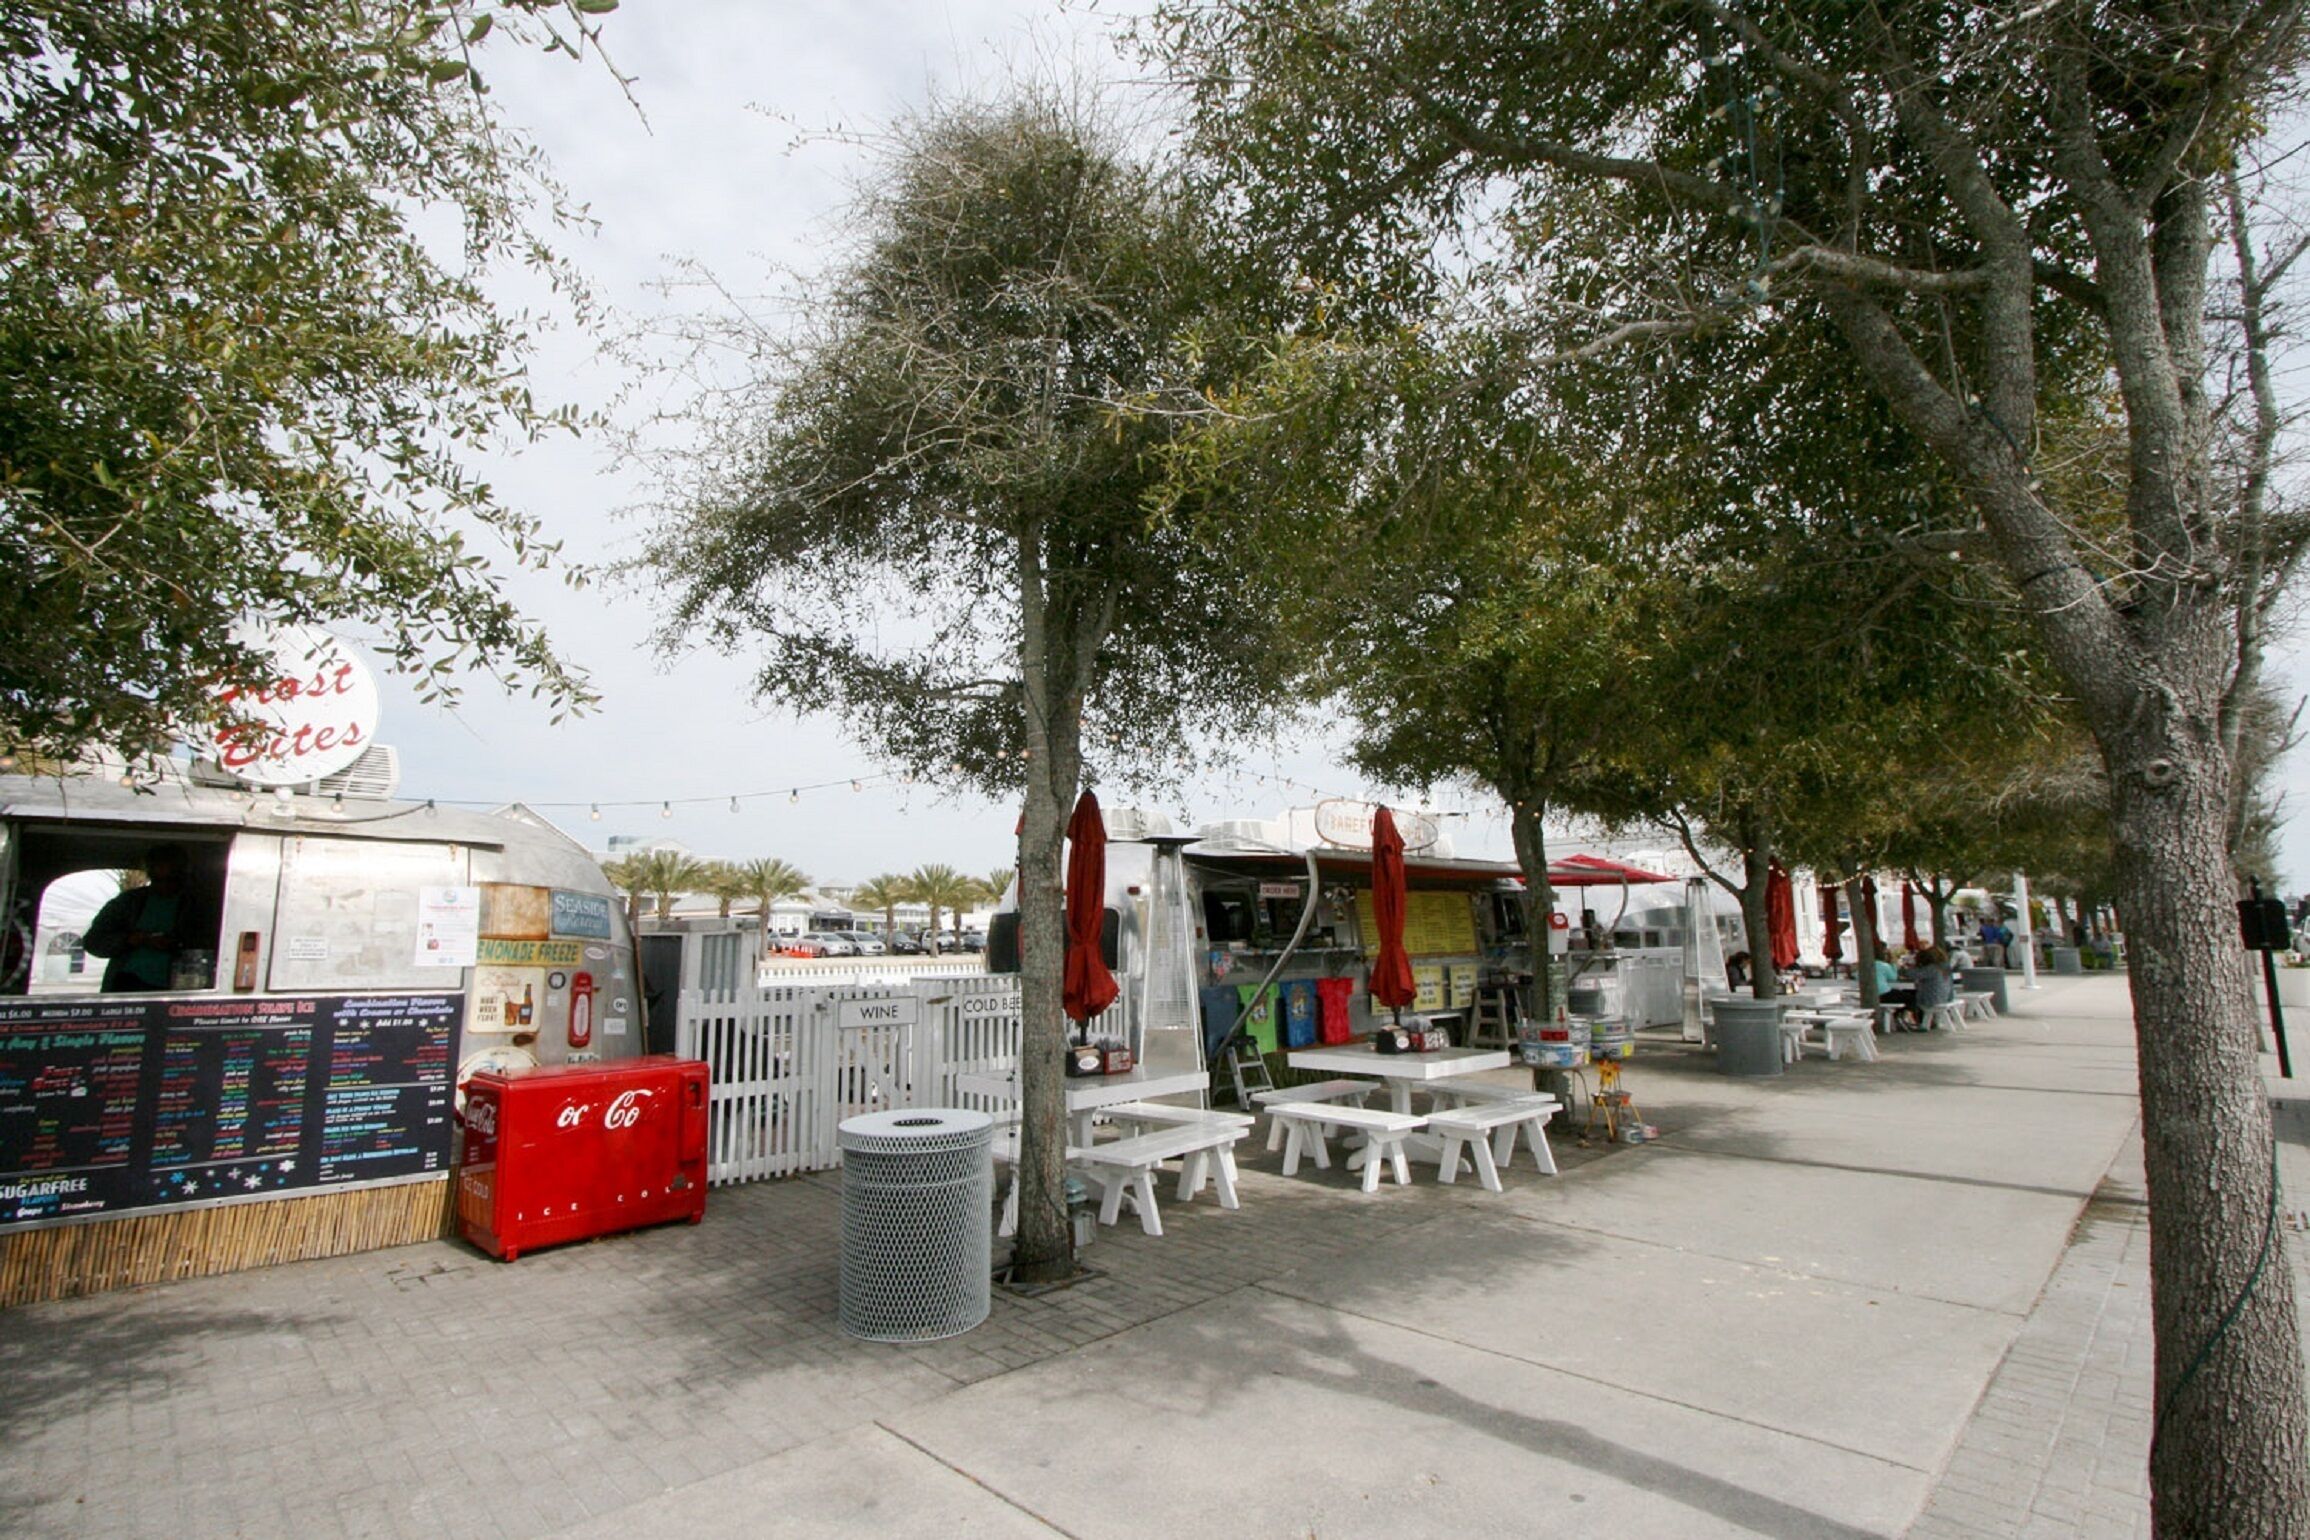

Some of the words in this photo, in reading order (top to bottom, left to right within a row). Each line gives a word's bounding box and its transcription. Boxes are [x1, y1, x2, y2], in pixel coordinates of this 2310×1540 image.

[477, 941, 535, 961] EMONADE
[860, 1004, 899, 1019] WINE
[964, 998, 998, 1013] COLD
[1002, 996, 1022, 1010] BEE
[0, 1178, 88, 1200] SUGARFREE
